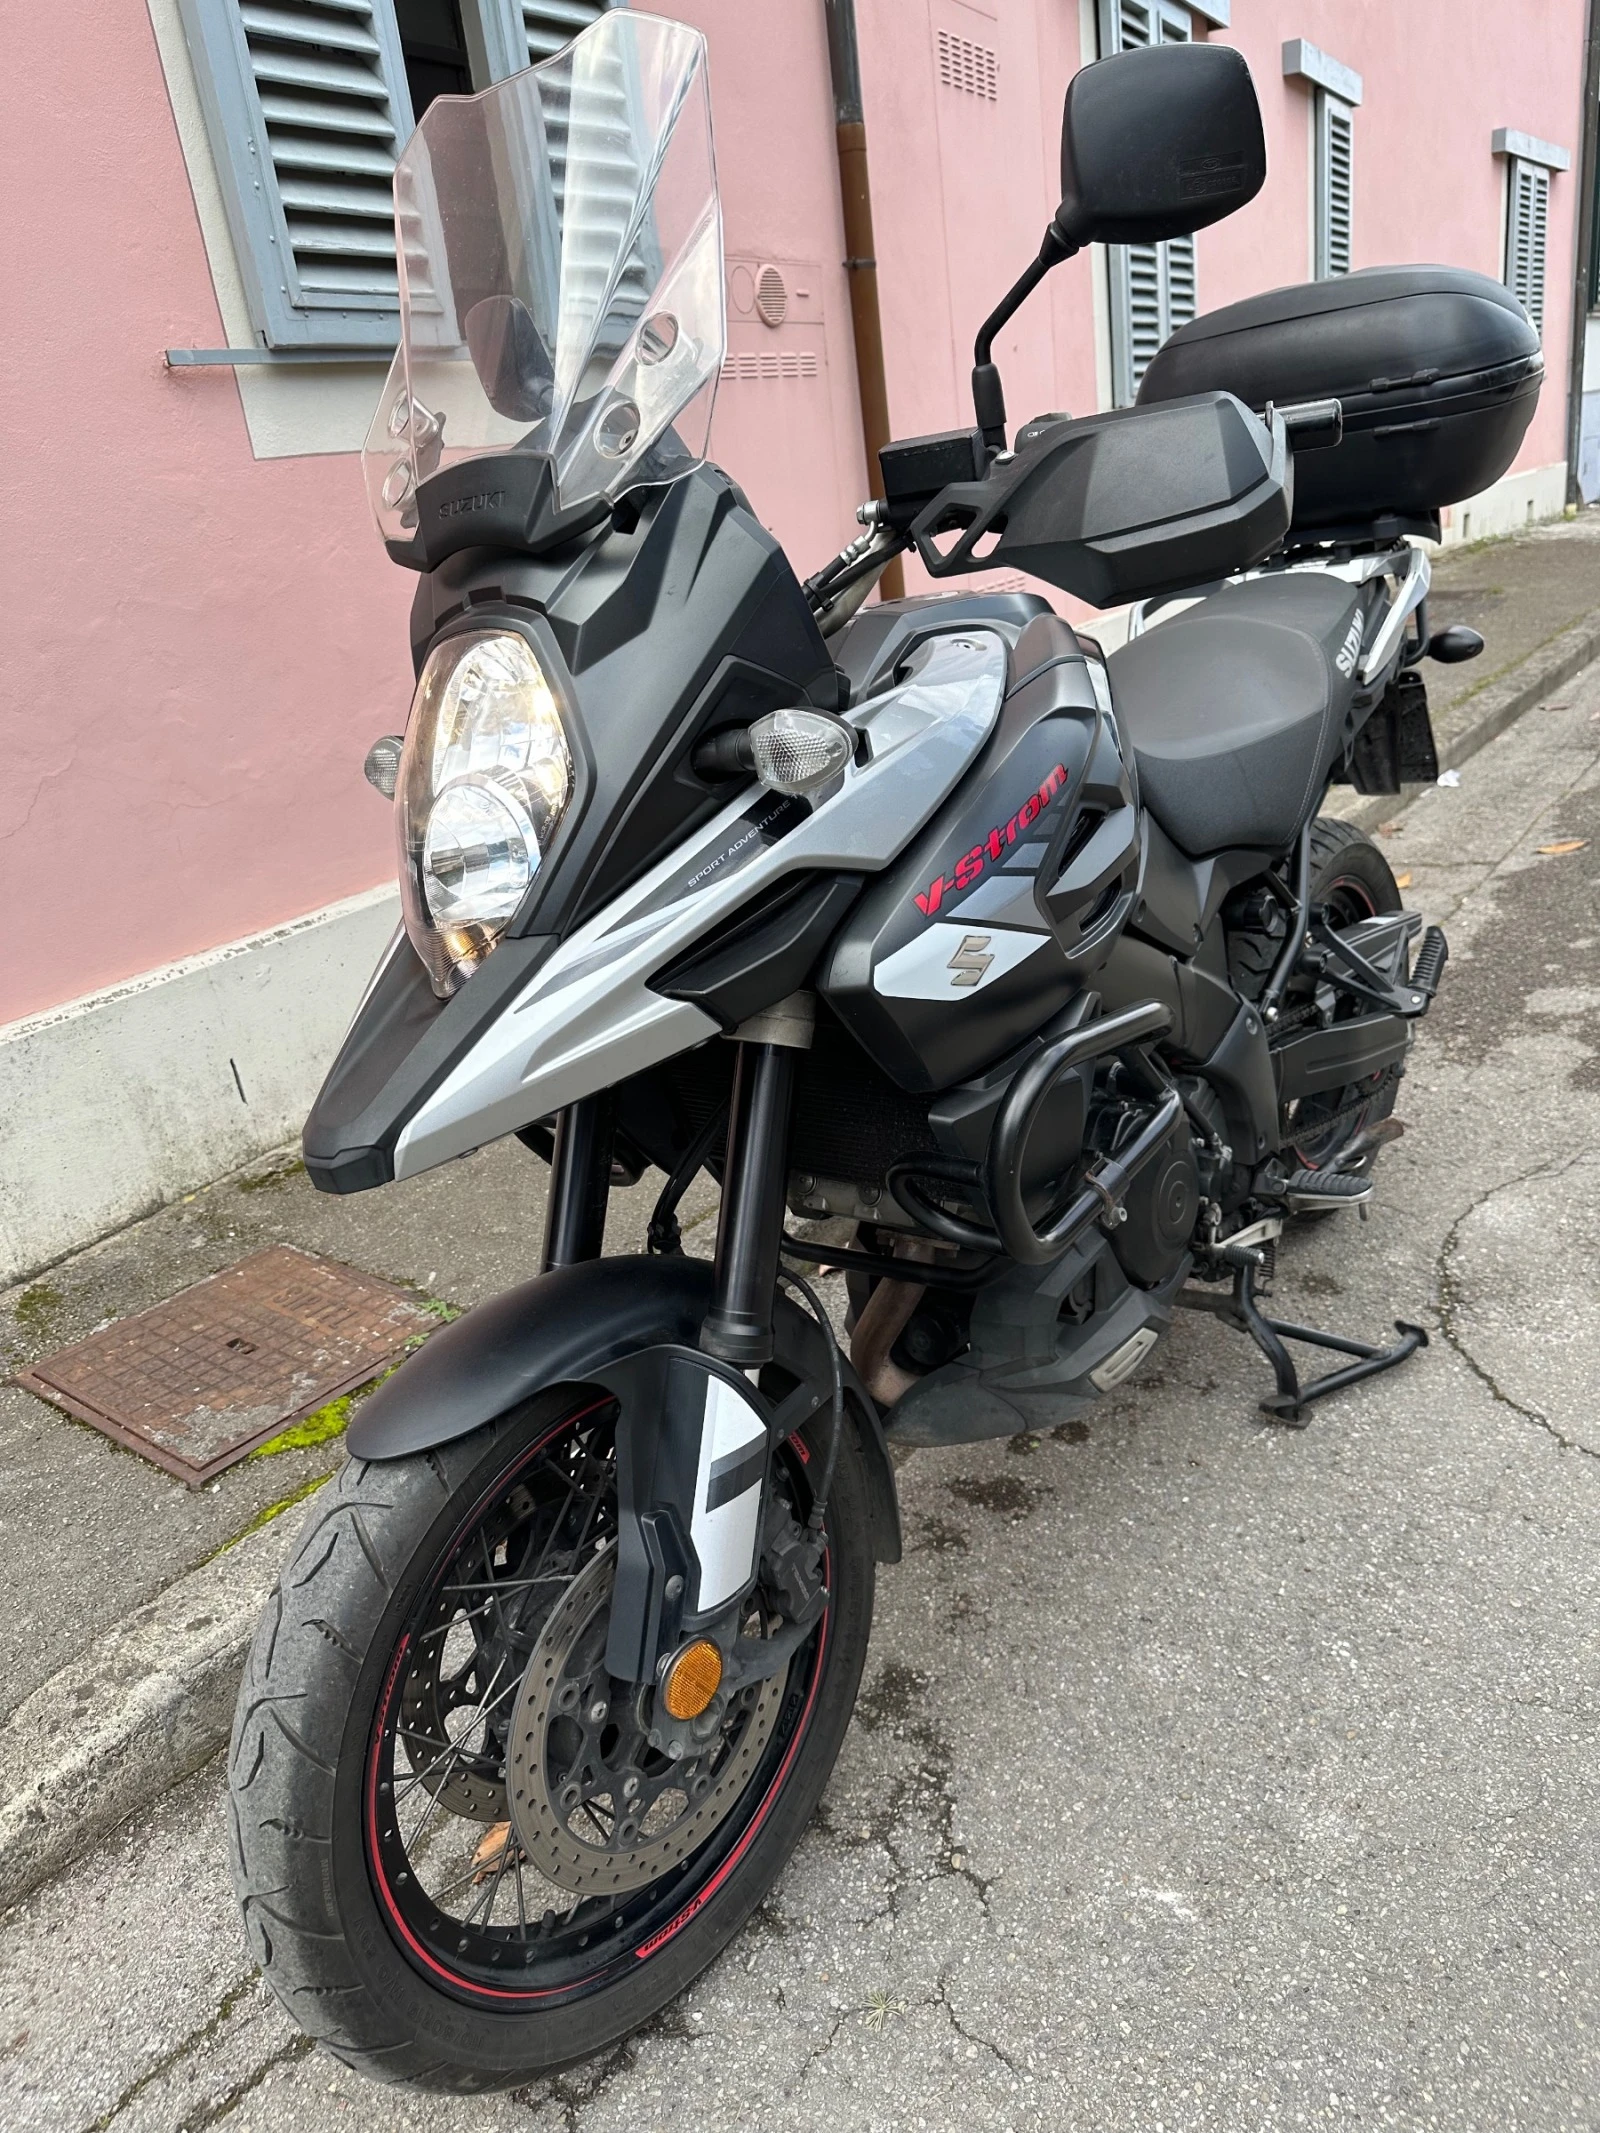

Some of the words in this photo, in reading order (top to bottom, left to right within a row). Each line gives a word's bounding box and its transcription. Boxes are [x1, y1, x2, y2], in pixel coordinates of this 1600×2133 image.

[438, 490, 506, 520] SUZUKI
[687, 852, 727, 888] SPORT
[727, 799, 792, 857] ADVENTURE
[912, 761, 1069, 917] V-Strom
[643, 1897, 703, 1952] V-Strom
